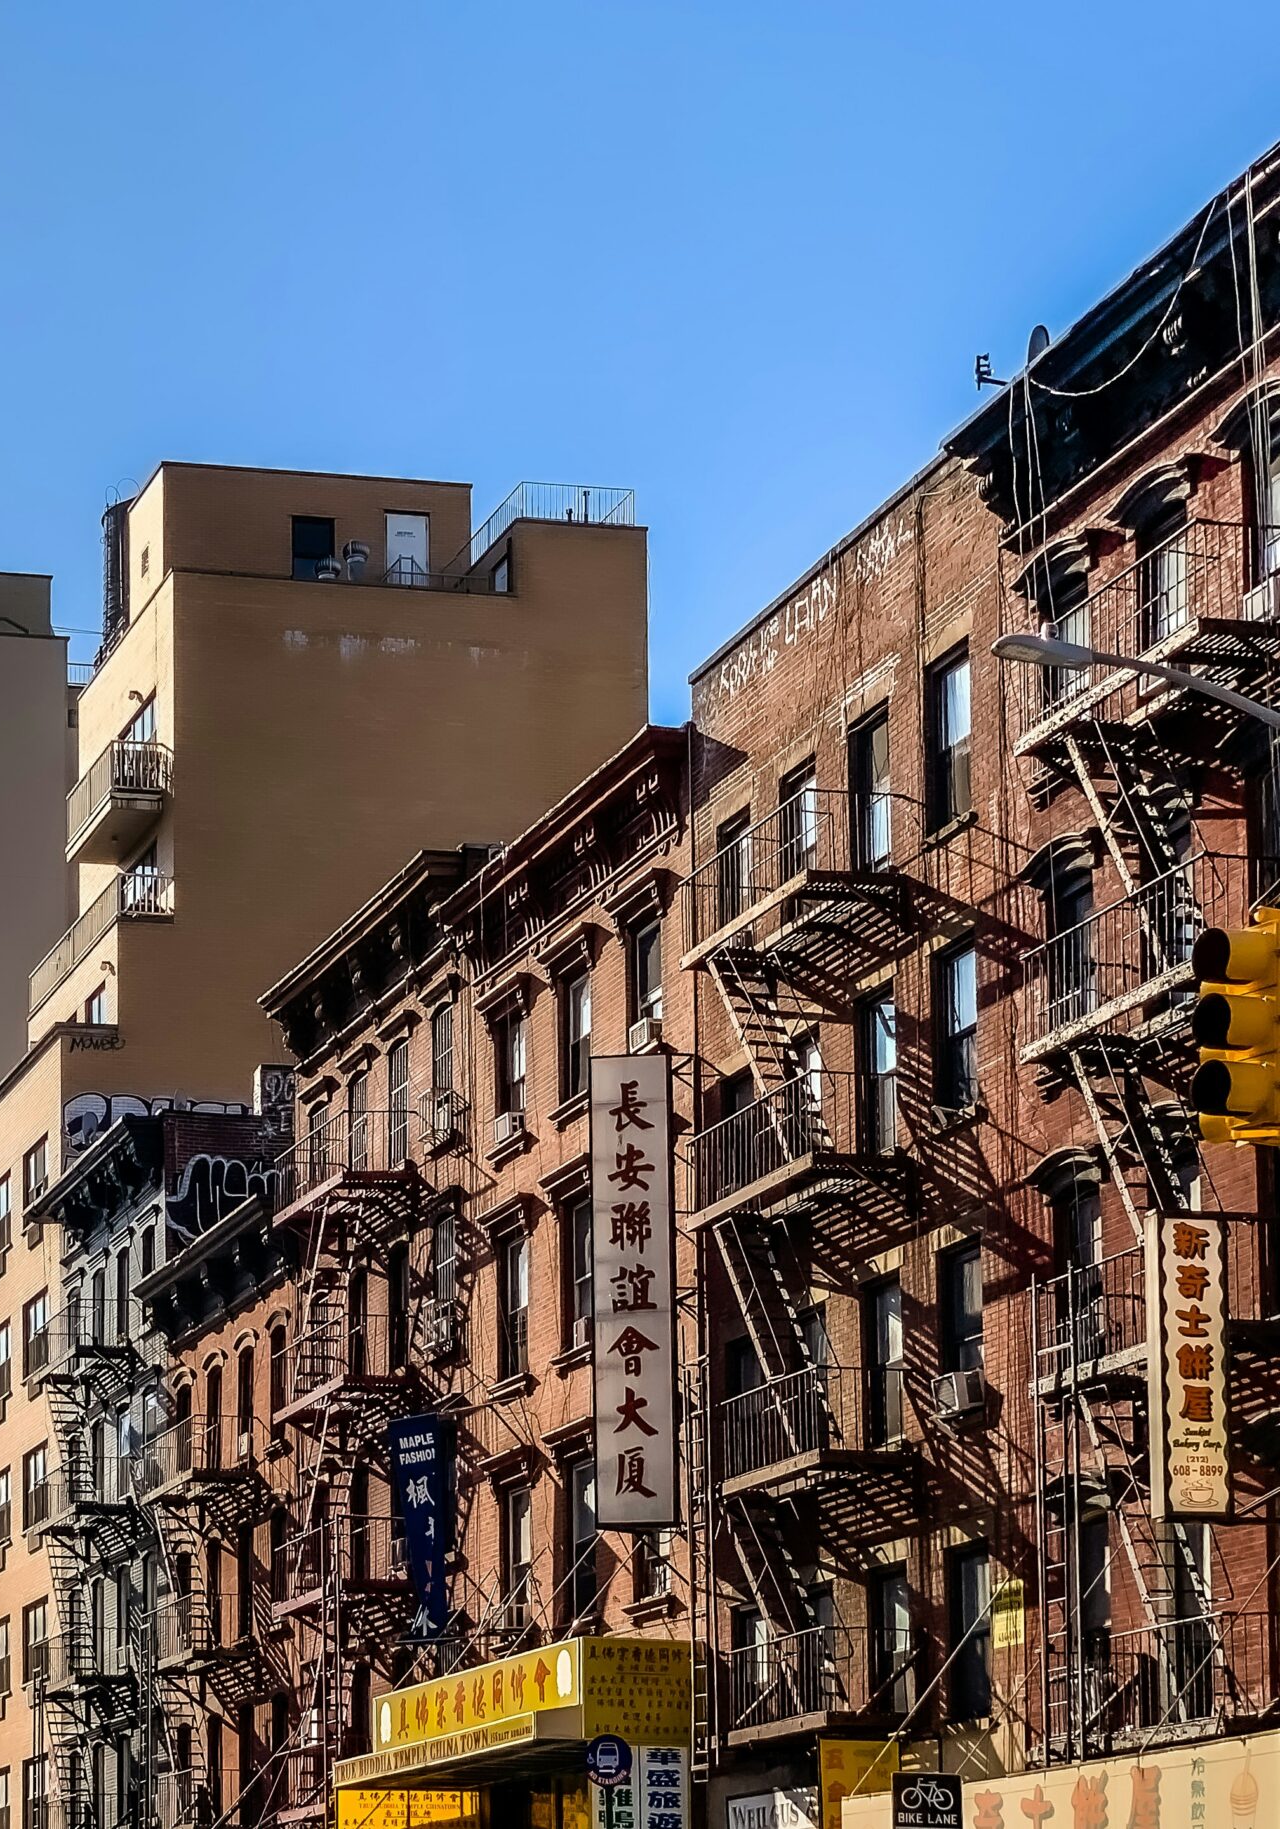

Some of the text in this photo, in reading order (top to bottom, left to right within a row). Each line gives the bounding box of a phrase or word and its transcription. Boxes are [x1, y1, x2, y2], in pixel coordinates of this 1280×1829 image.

[1173, 1222, 1215, 1422] 新奇士餅屋
[399, 1432, 434, 1449] MAPLE
[1173, 1438, 1200, 1452] Bakery
[335, 1762, 357, 1783] TRUE
[359, 1753, 392, 1777] BUDDHA
[393, 1745, 427, 1769] TEMPLE
[588, 1769, 627, 1784] NO STANDING
[1191, 1756, 1206, 1829] 冷熱飲
[897, 1812, 958, 1825] BIKE LANE
